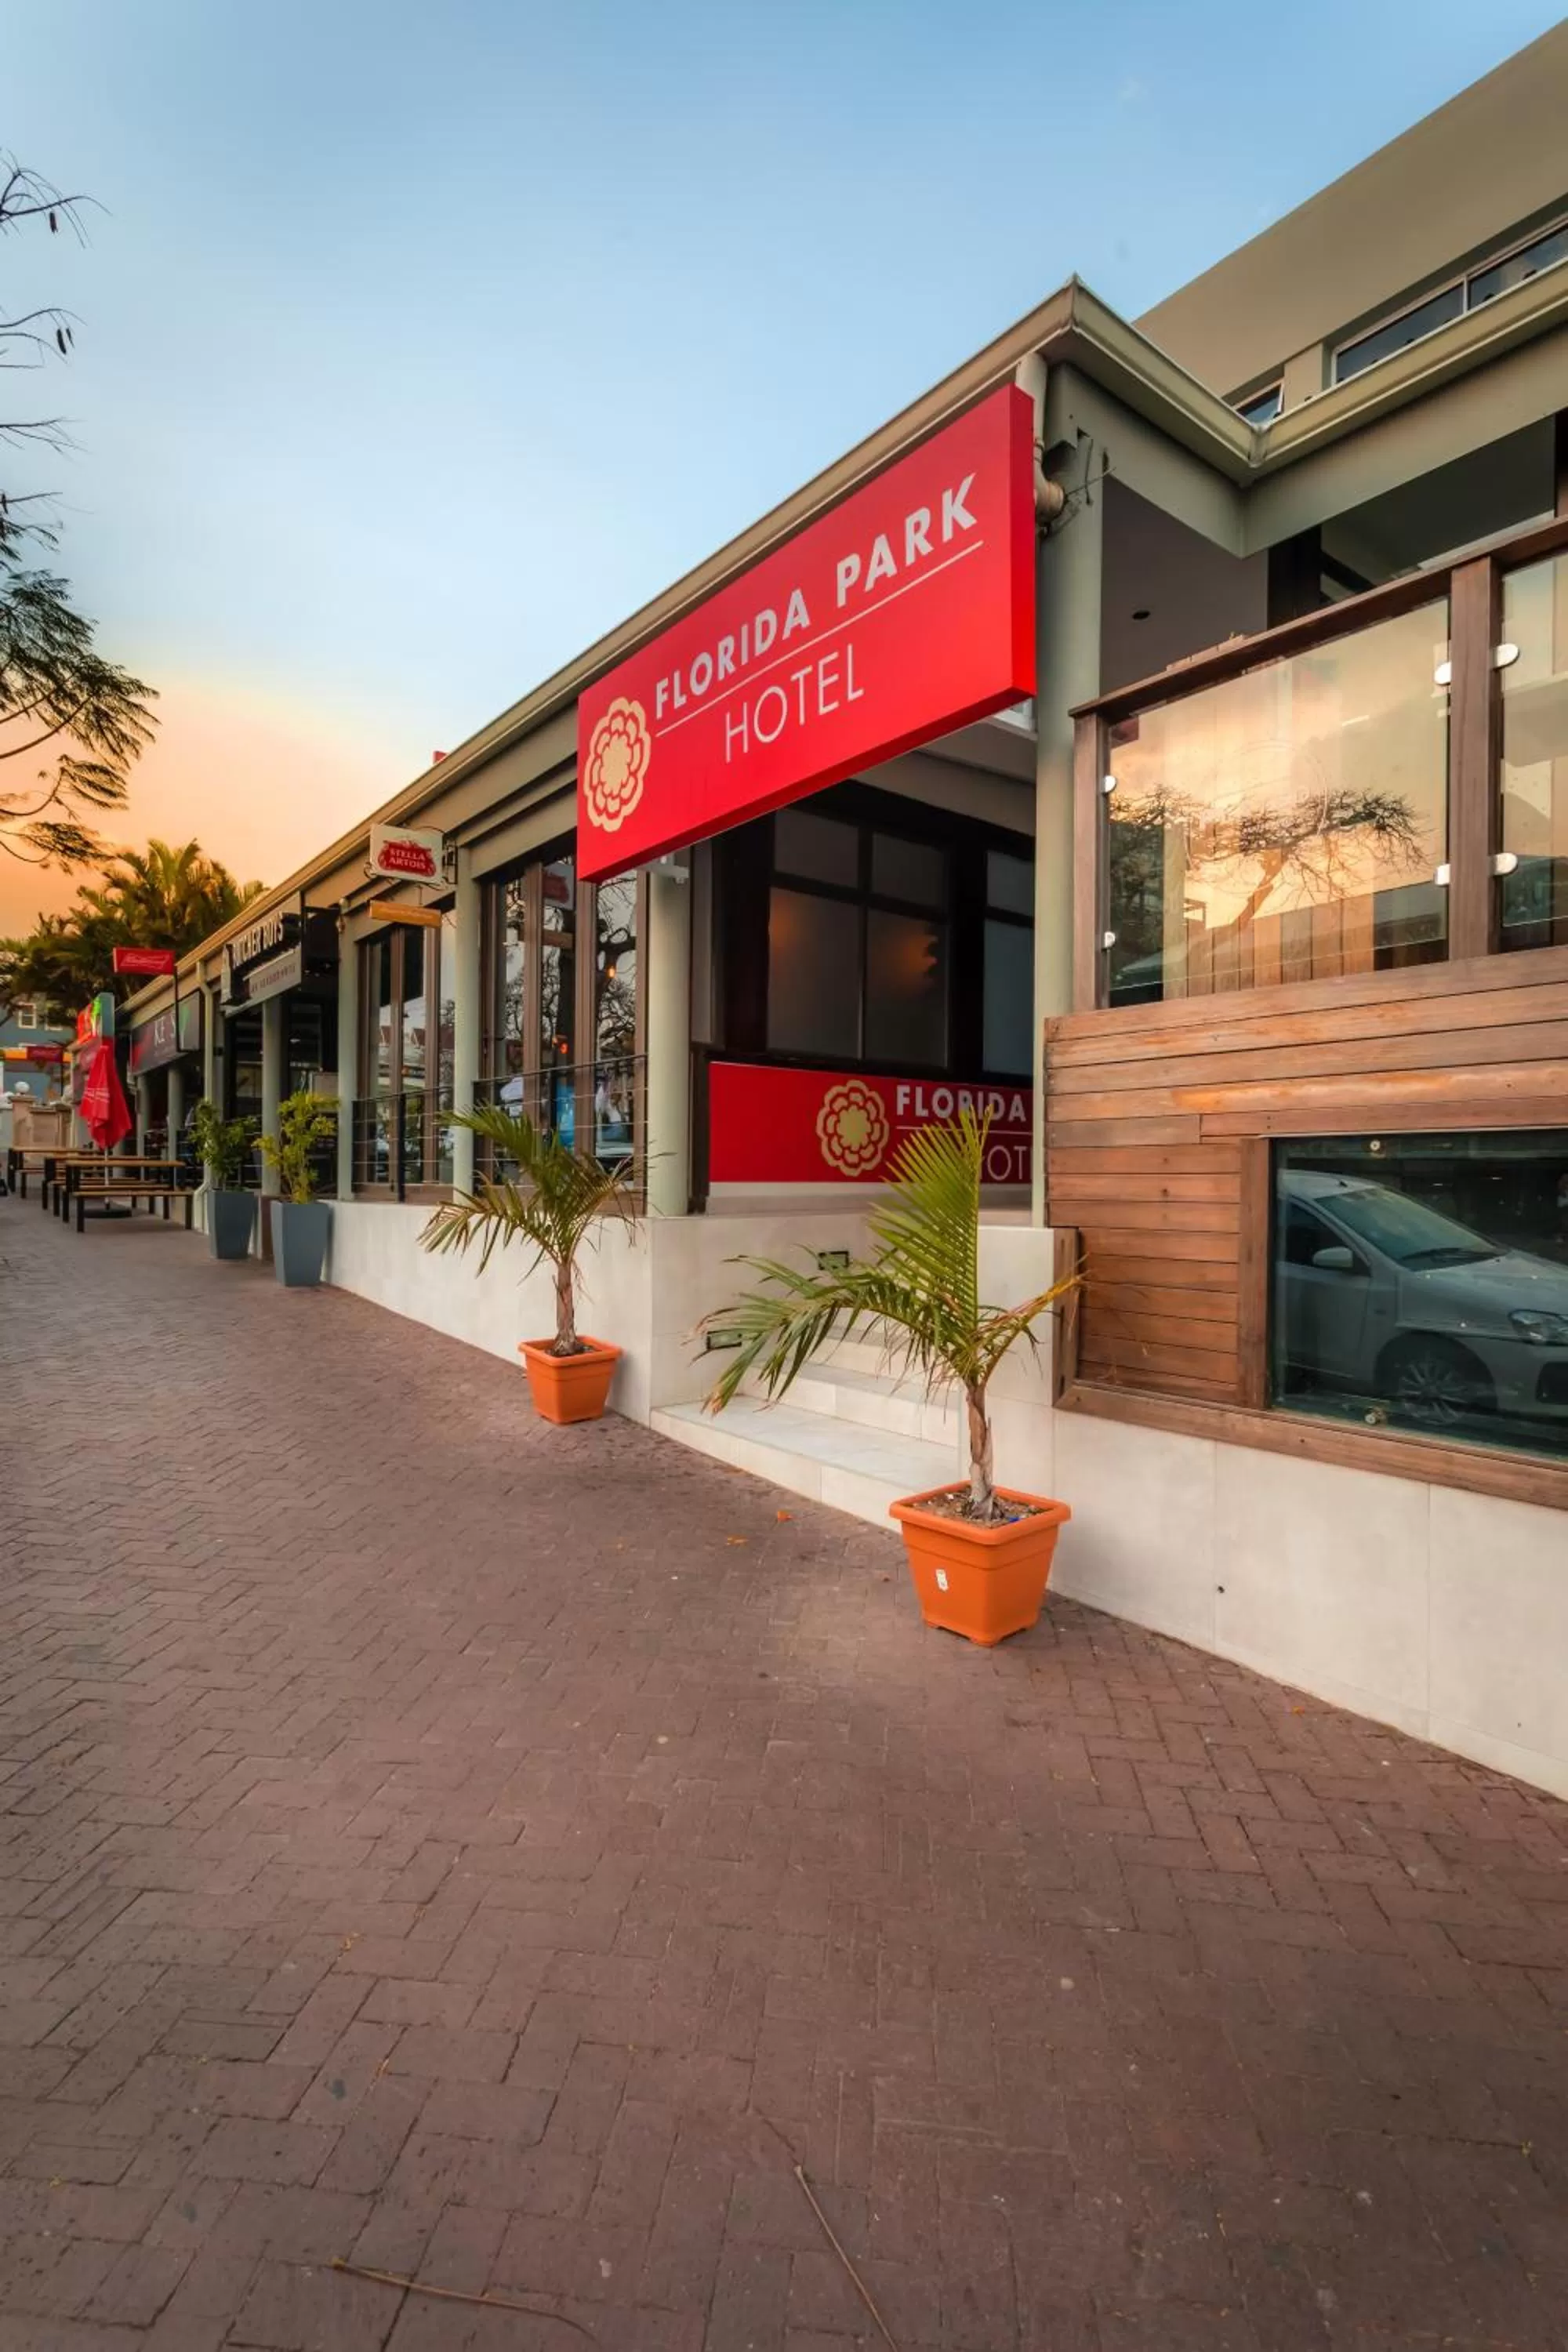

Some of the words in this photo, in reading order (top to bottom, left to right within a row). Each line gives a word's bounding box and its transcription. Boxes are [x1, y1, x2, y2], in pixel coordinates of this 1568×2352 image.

[655, 588, 810, 720] FLORIDA
[837, 473, 978, 608] PARK
[725, 644, 865, 763] HOTEL
[896, 1084, 1026, 1122] FLORIDA
